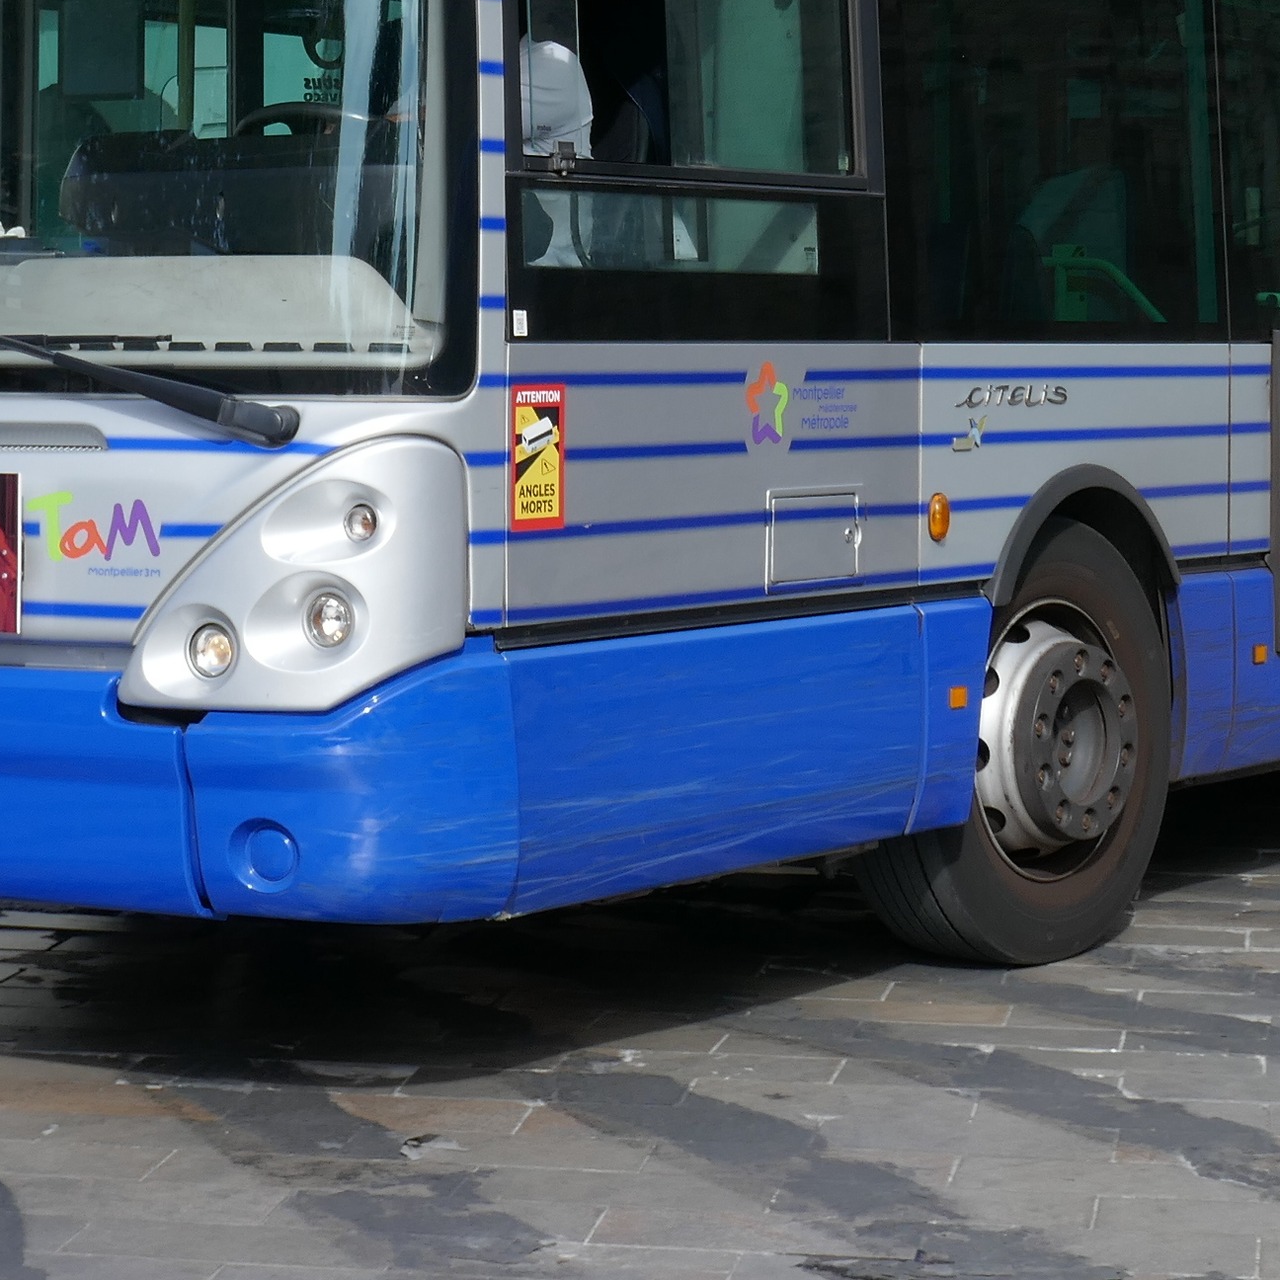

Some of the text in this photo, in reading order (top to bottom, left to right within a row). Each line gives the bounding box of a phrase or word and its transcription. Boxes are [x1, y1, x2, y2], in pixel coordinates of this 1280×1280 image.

[516, 390, 560, 403] ATTENTION
[519, 483, 555, 498] ANGLES
[521, 499, 553, 514] MORTS
